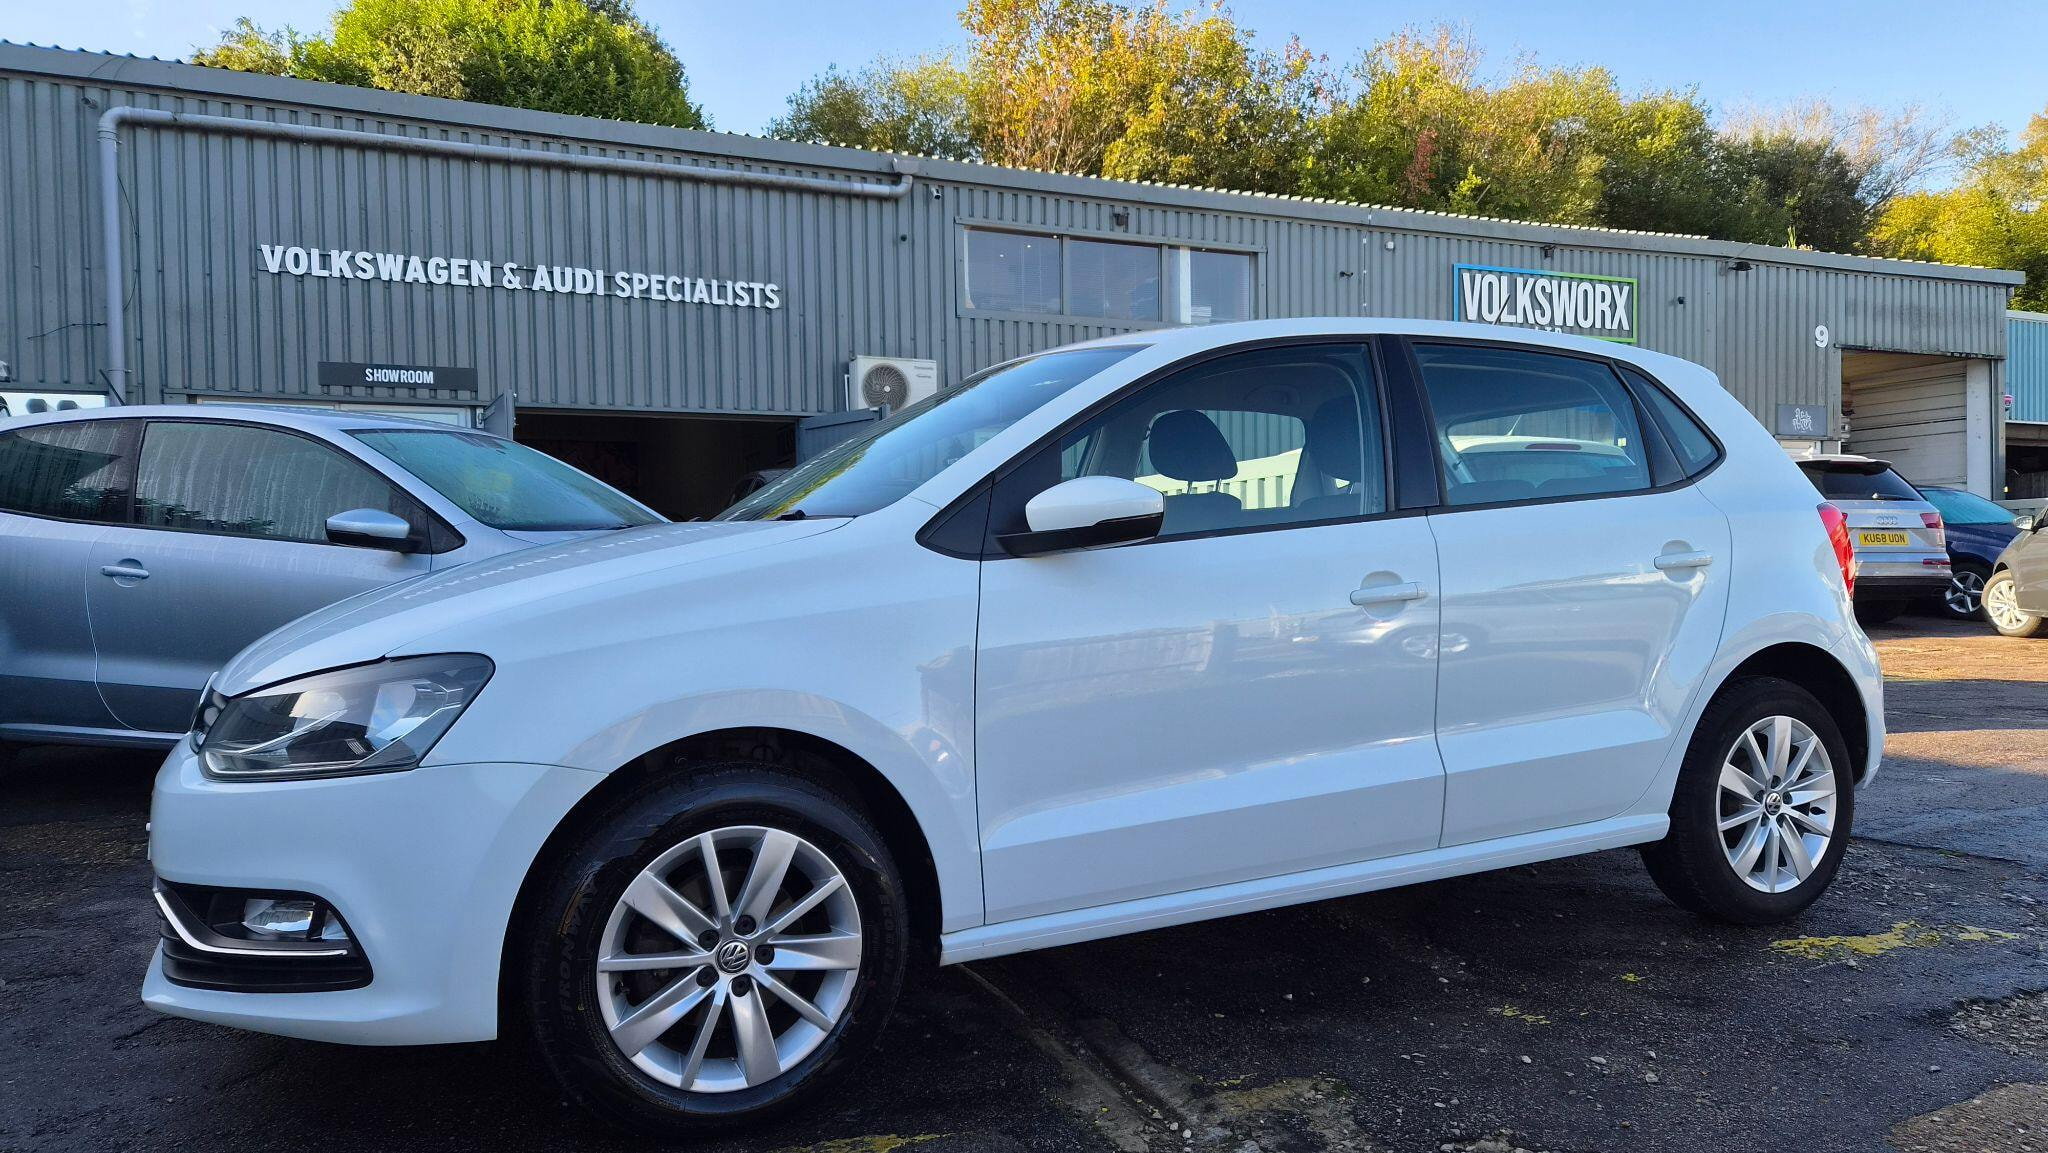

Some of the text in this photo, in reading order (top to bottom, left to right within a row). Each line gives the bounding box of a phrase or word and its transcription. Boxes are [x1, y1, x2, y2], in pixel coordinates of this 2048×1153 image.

[260, 244, 781, 309] VOLKSWAGEN & AUDI SPECIALISTS
[1462, 272, 1631, 331] VOLKSWORX
[1815, 324, 1829, 348] 9
[365, 368, 434, 384] SHOWROOM
[1863, 533, 1887, 544] KU68
